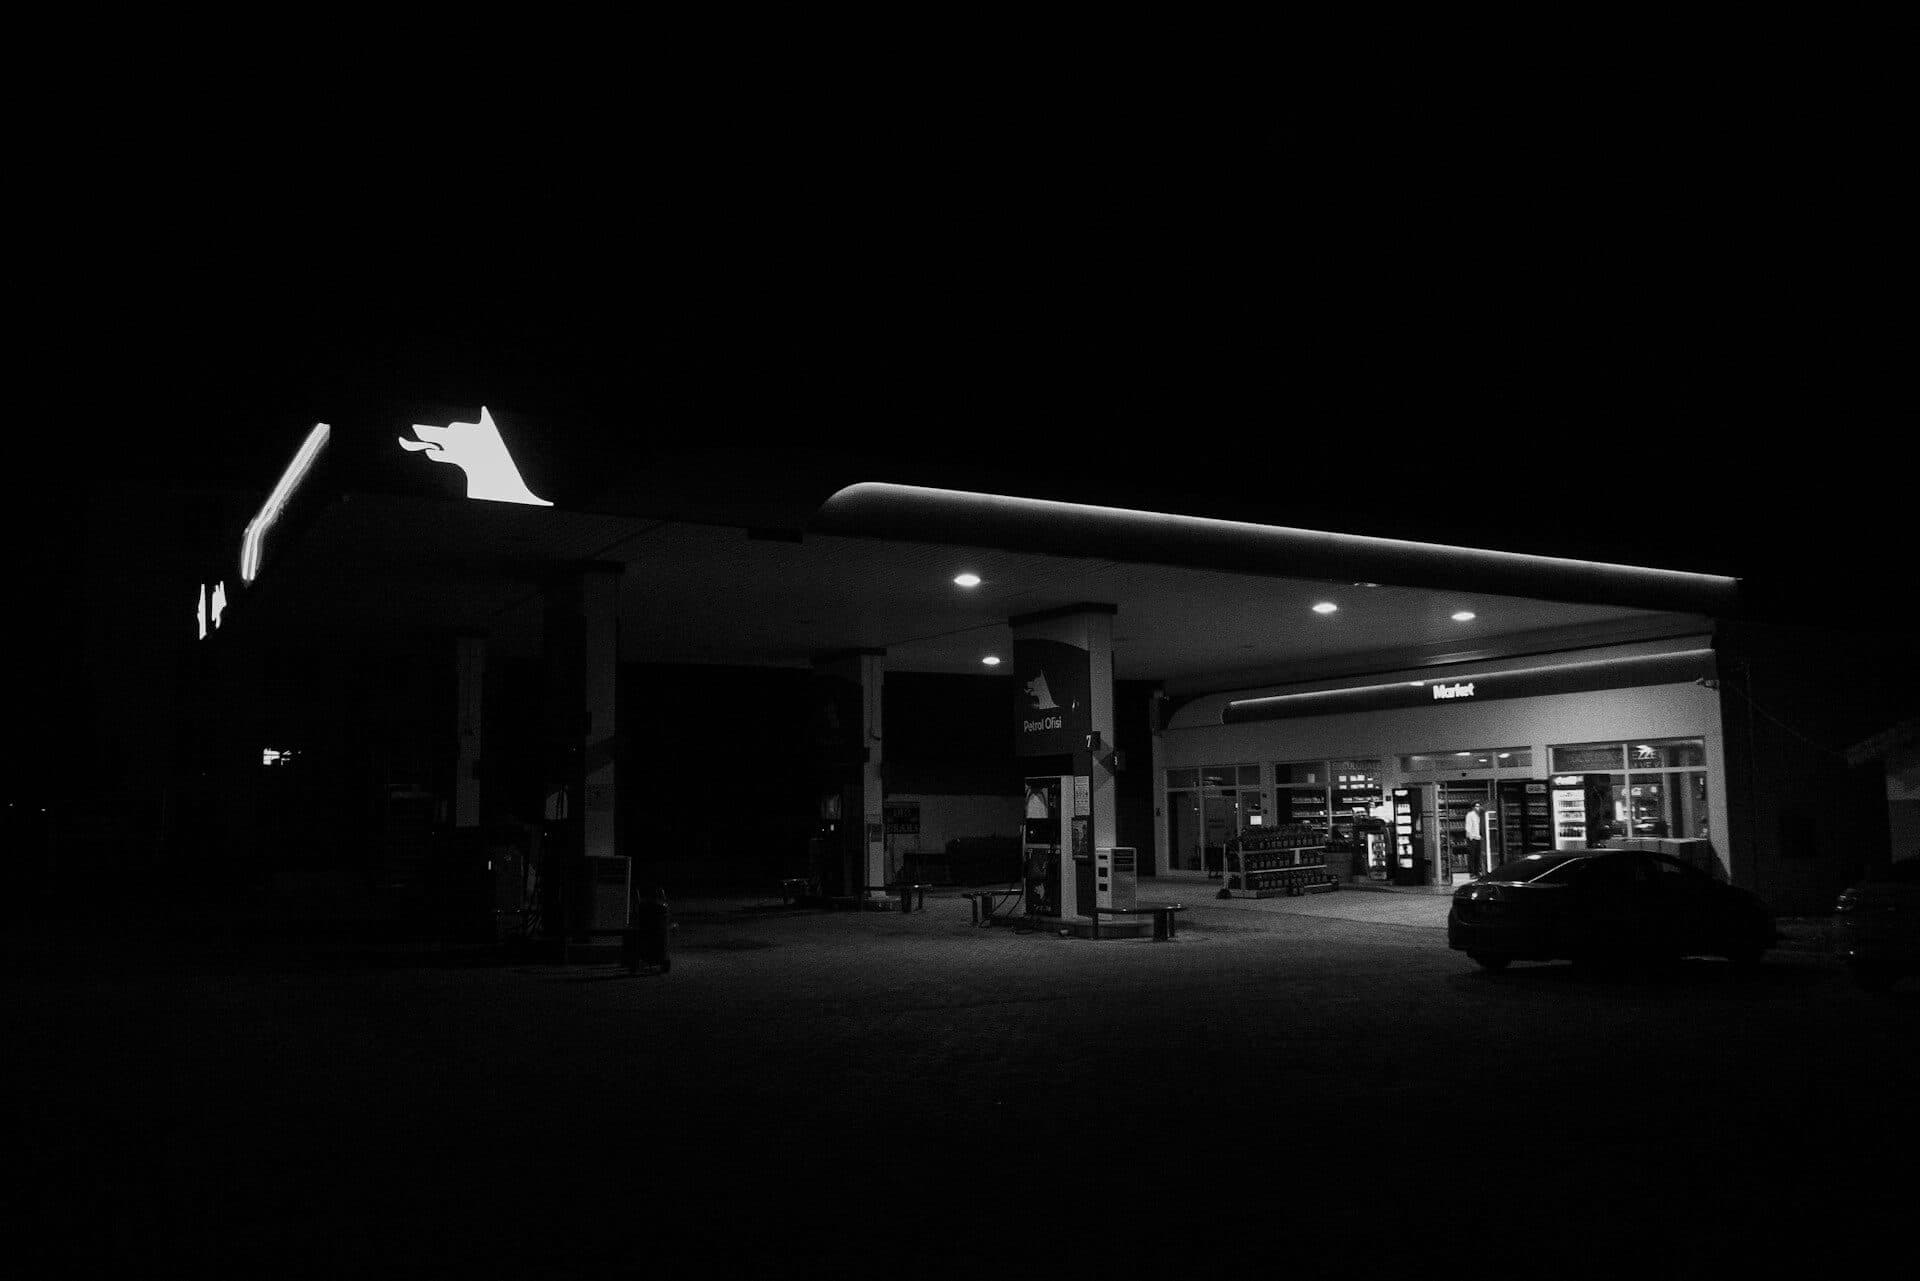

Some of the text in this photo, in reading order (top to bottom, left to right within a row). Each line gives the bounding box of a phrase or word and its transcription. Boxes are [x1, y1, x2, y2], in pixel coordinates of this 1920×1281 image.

[1433, 683, 1474, 700] Market
[1024, 719, 1044, 732] Petrol
[1086, 735, 1092, 747] 7
